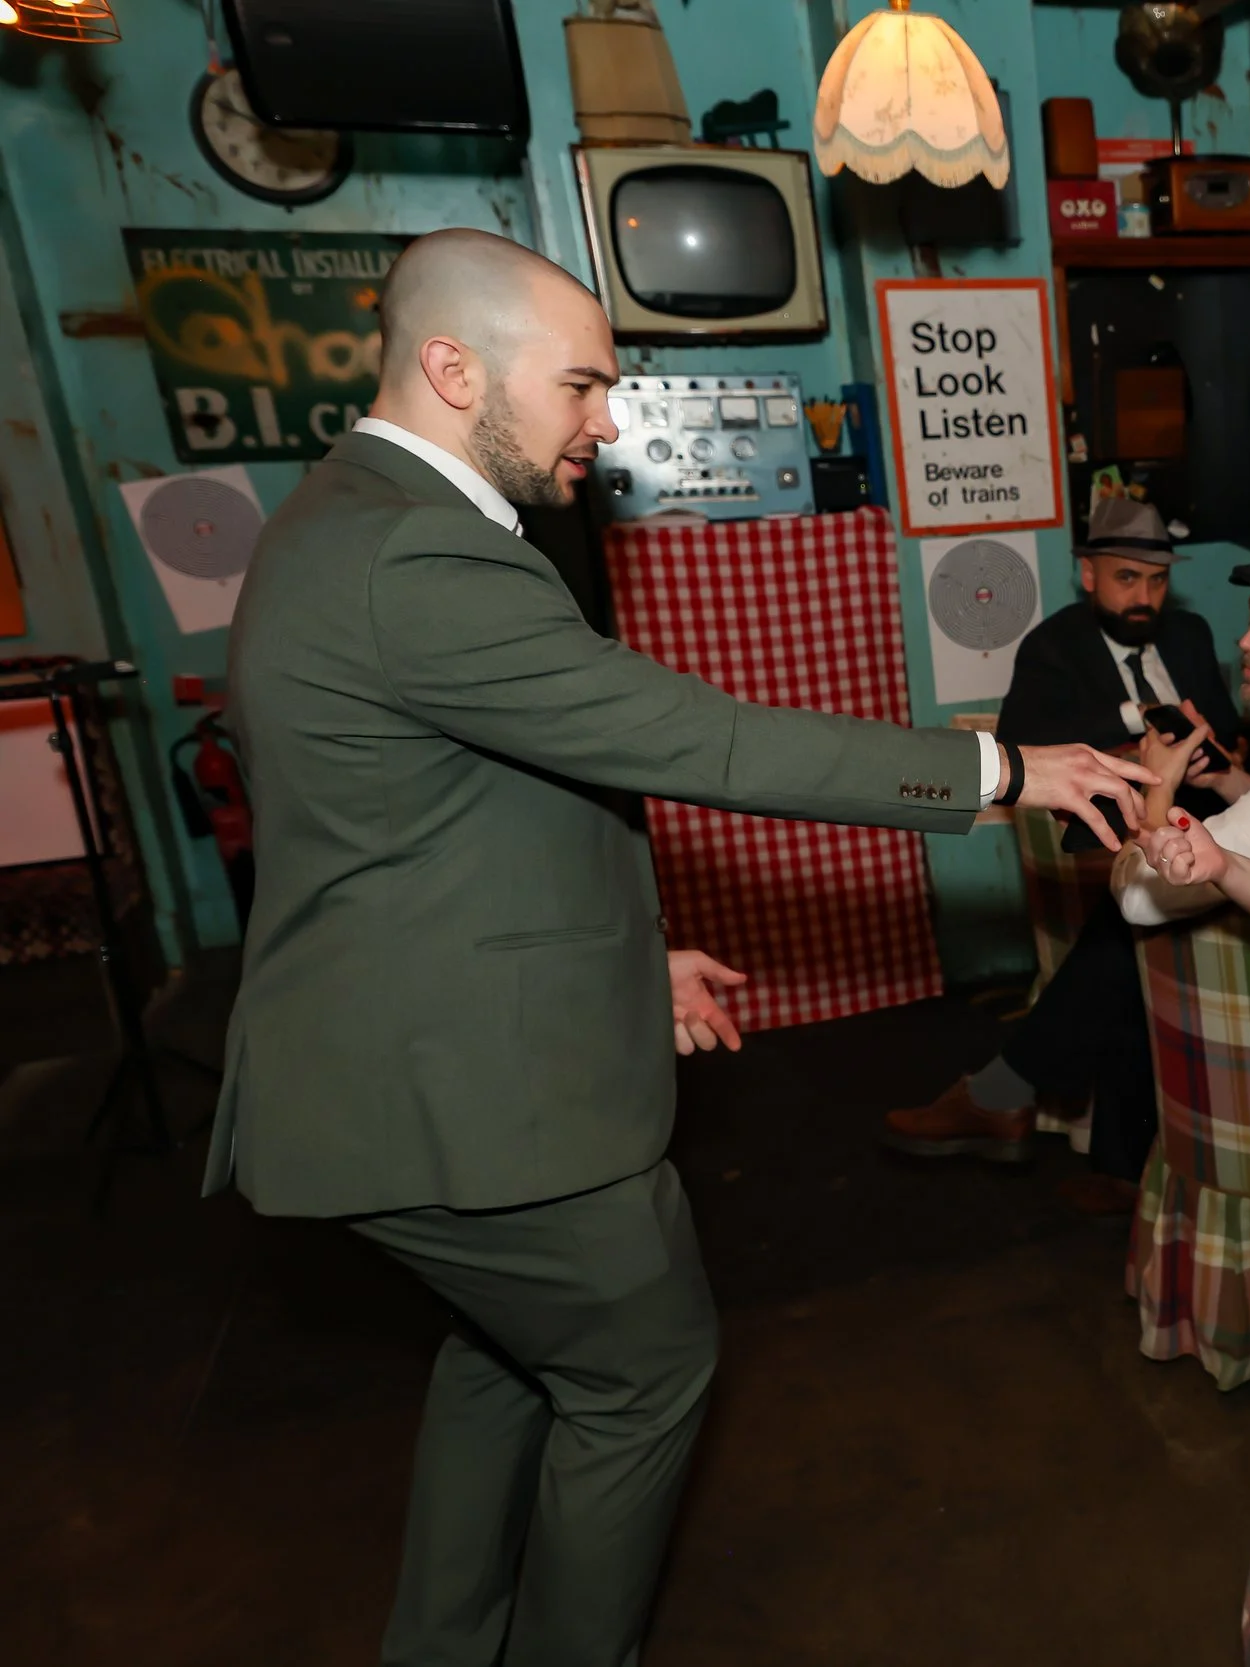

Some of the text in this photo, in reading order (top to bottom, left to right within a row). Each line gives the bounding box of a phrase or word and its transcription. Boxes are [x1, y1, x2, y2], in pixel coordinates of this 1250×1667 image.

[1060, 198, 1107, 218] OXO
[292, 247, 397, 278] INSTALLA
[911, 321, 998, 359] Stop
[914, 364, 1007, 398] Look
[174, 386, 300, 451] B.I.
[919, 408, 1028, 441] Listen
[925, 462, 1004, 482] Beware
[928, 483, 1021, 507] of trains
